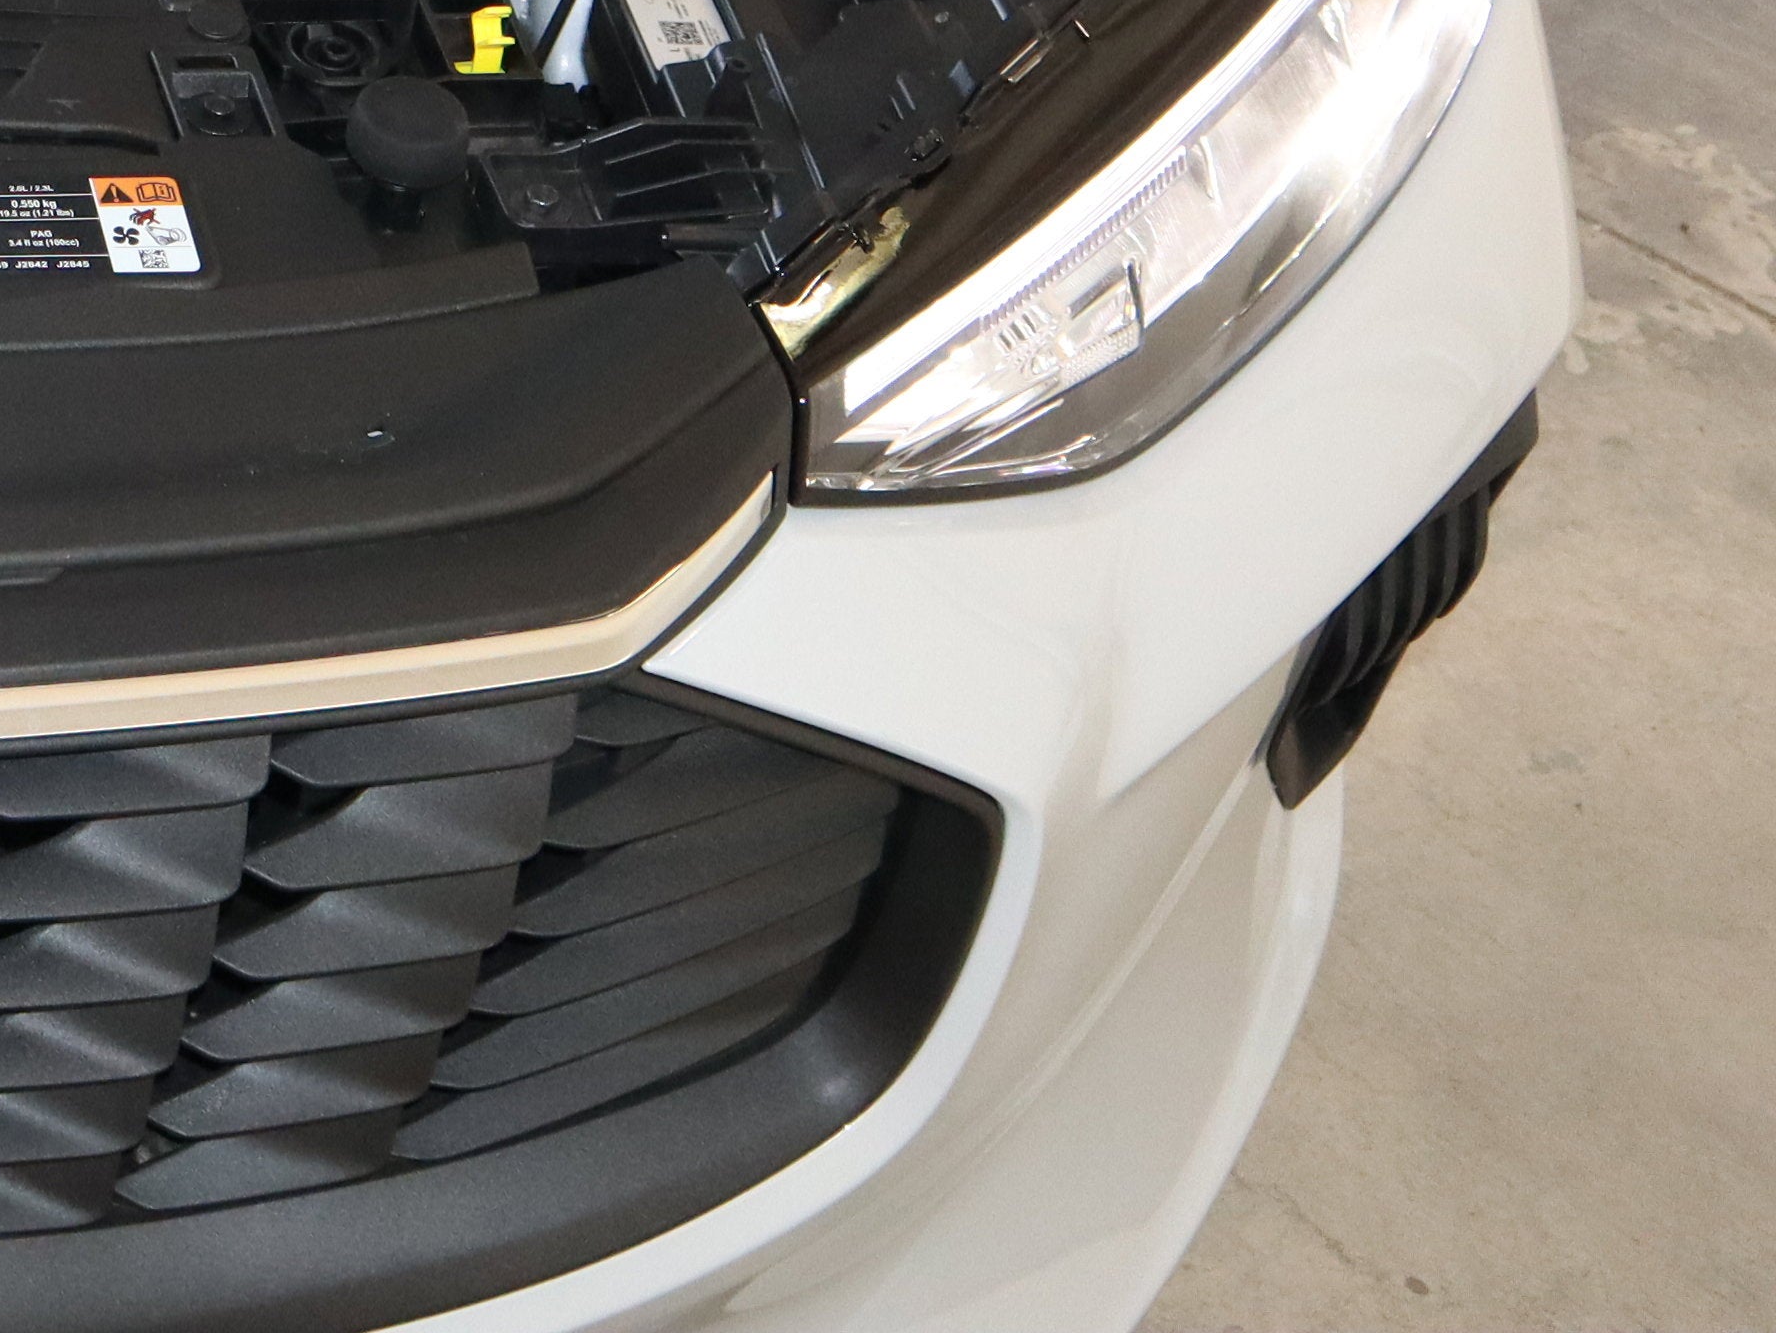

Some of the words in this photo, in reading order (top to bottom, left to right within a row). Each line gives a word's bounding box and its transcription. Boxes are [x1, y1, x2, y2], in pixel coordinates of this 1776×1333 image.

[10, 199, 41, 209] 0.550
[42, 199, 57, 210] kg
[30, 229, 53, 238] PAG
